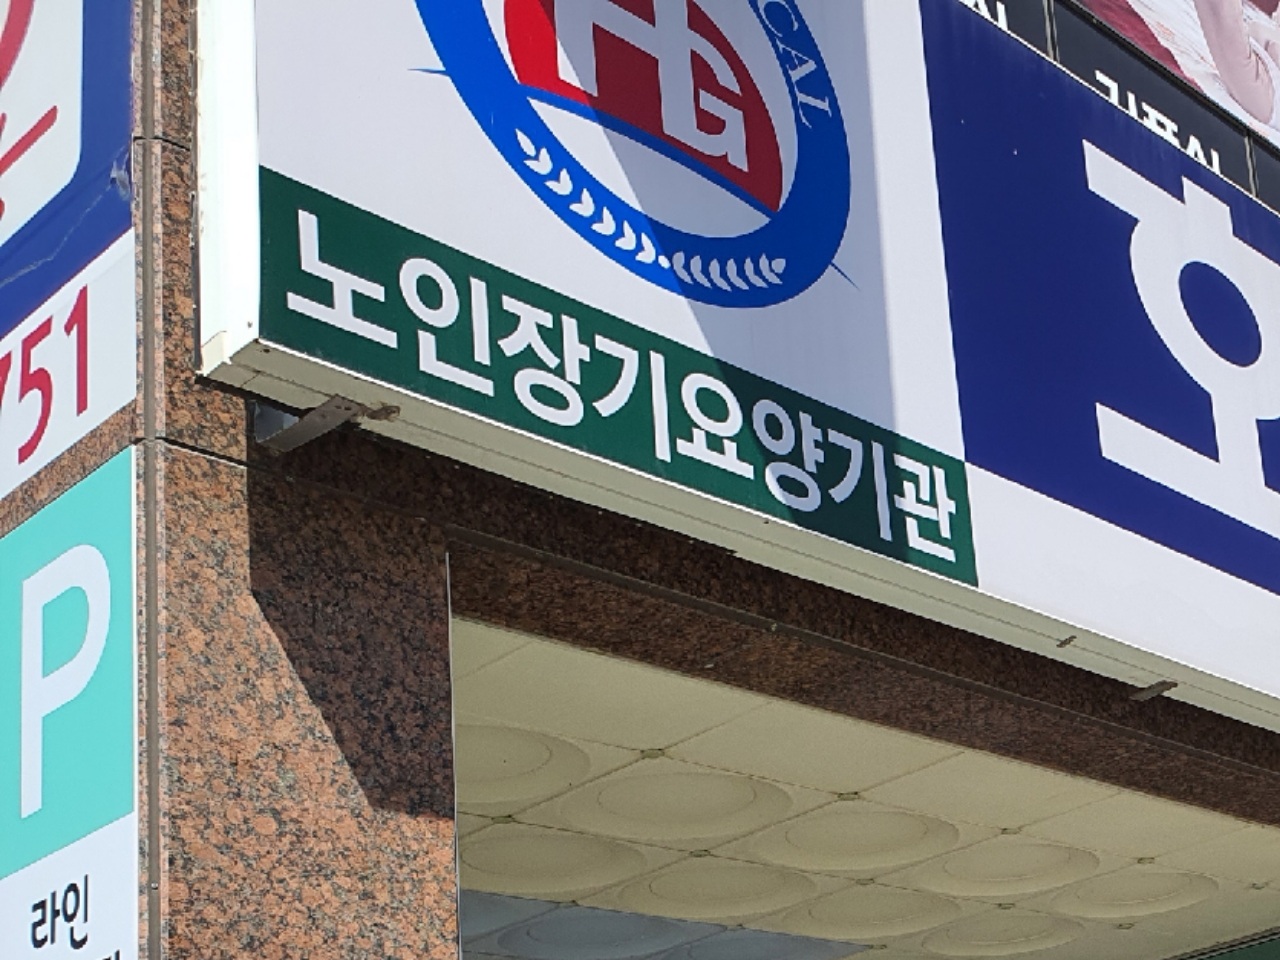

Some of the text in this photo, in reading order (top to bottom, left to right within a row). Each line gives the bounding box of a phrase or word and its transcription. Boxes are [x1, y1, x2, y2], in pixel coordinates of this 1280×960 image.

[287, 209, 956, 563] 노인장기요양기관
[20, 543, 111, 820] P
[30, 874, 89, 949] 라인
